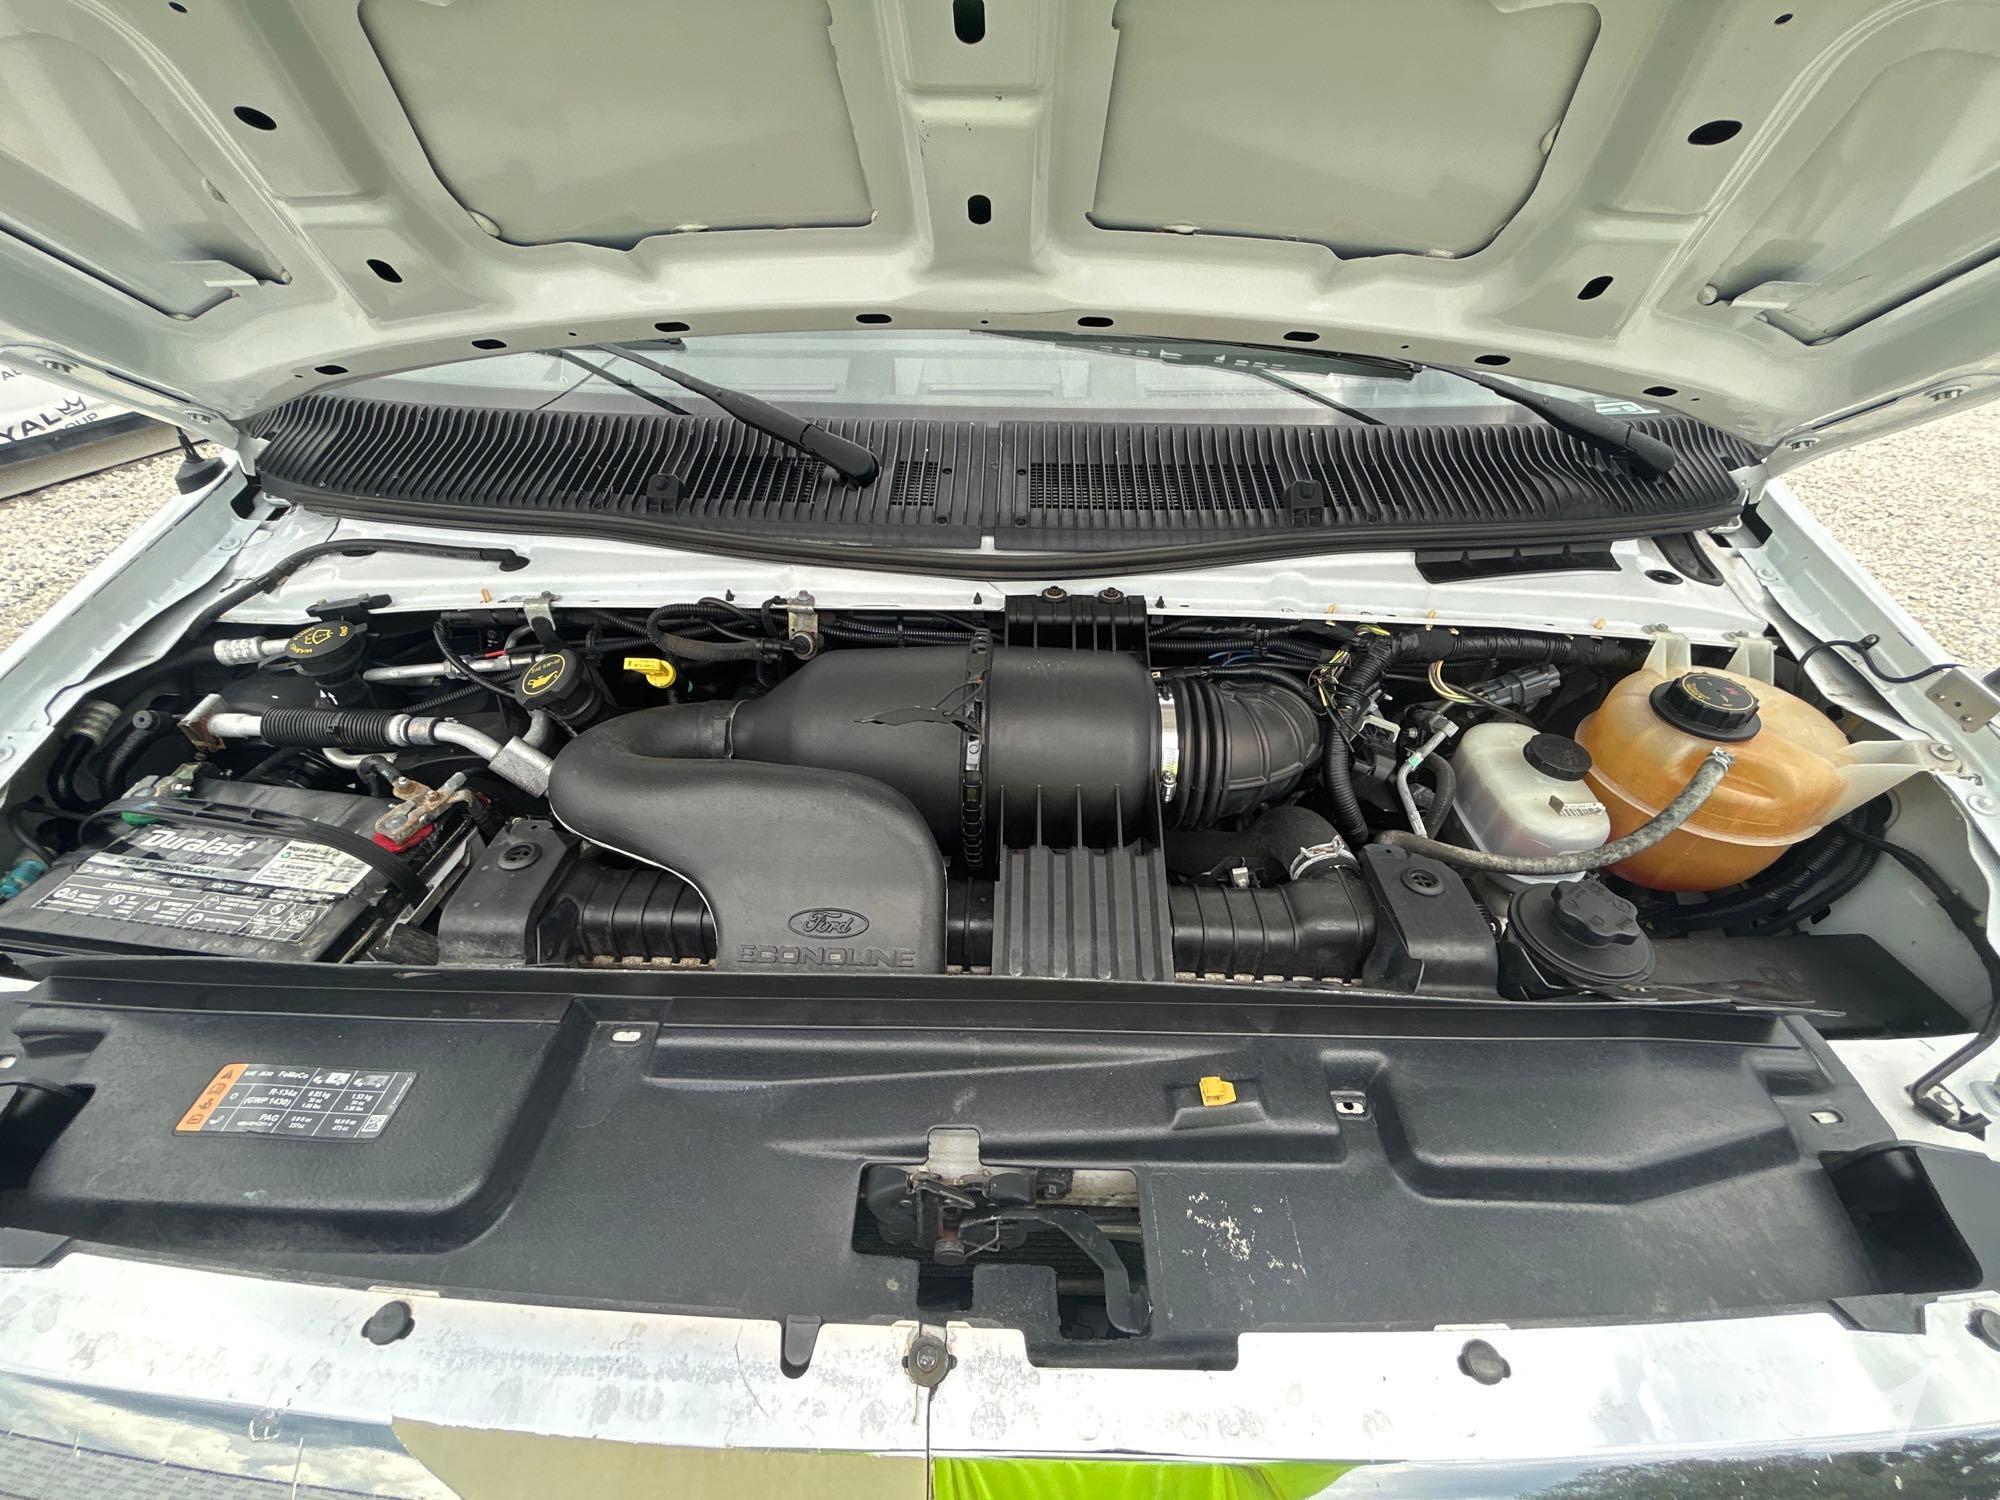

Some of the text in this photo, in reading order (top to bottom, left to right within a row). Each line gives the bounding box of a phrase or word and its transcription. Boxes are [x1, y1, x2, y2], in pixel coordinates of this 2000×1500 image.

[140, 829, 257, 857] Duralast
[118, 858, 220, 875] AGM TECHNOLOGY
[803, 911, 852, 934] Ford
[737, 944, 915, 968] ECONOLINE
[278, 1070, 309, 1079] FoMoCo
[268, 1087, 298, 1097] R-134a
[269, 1097, 292, 1107] 1430)
[258, 1113, 280, 1122] PAG
